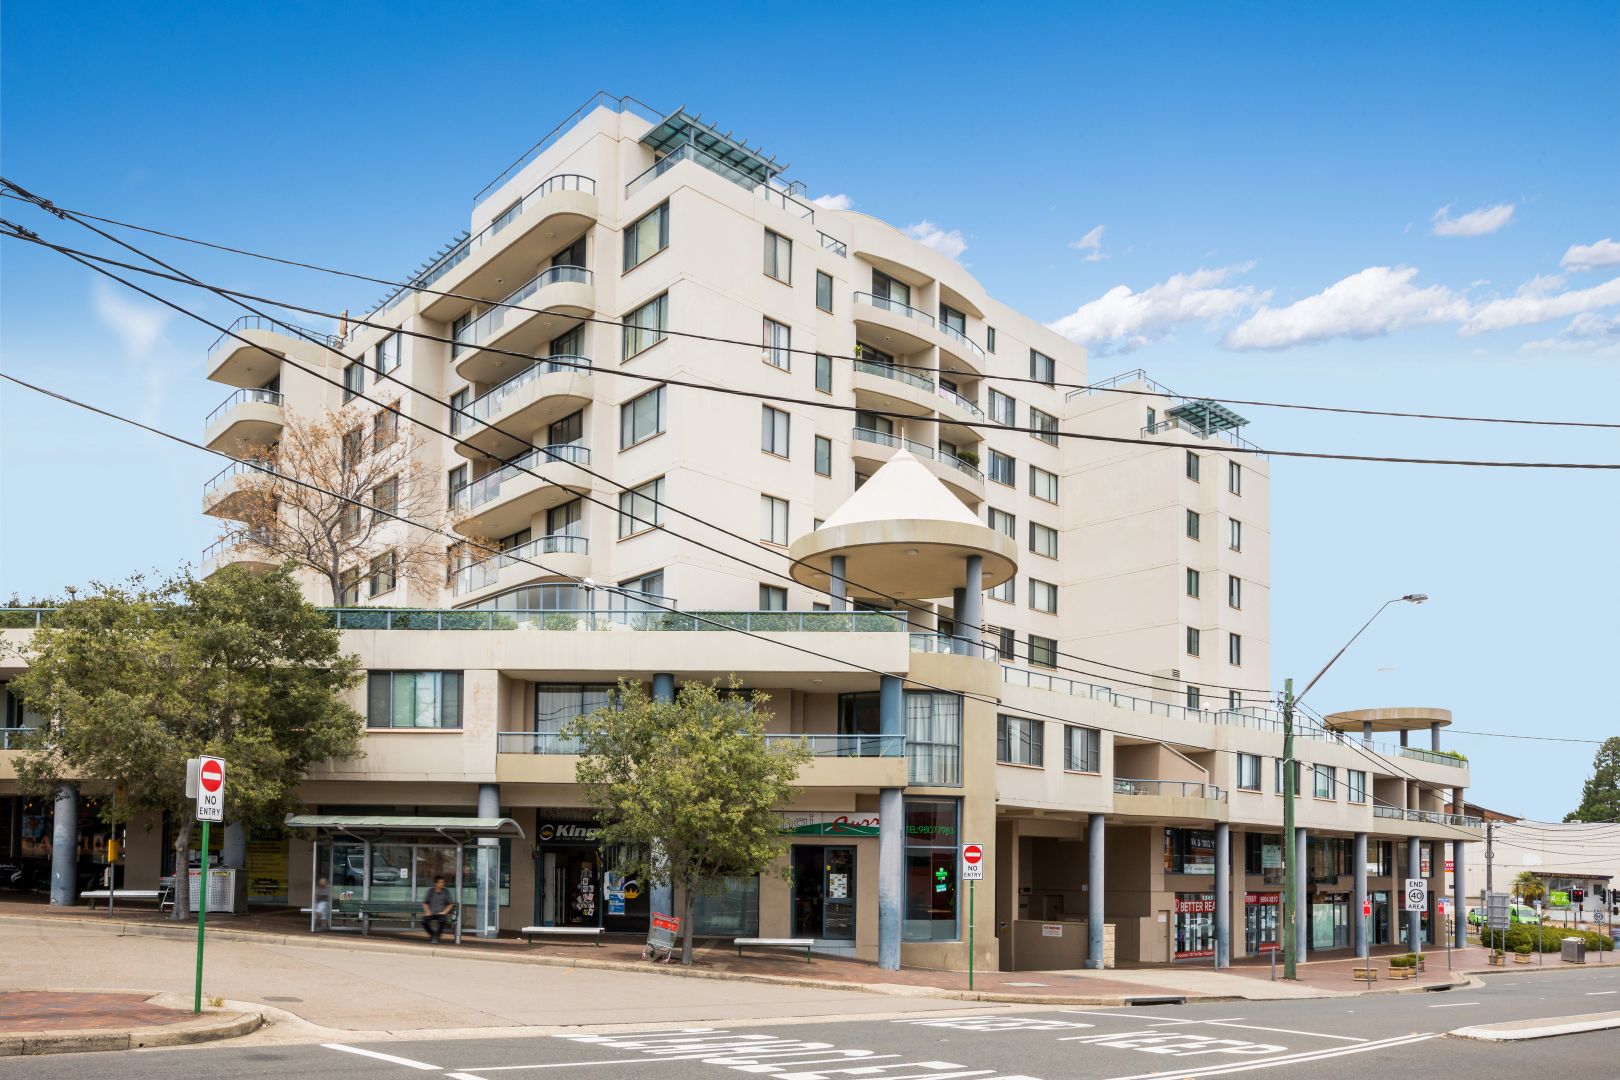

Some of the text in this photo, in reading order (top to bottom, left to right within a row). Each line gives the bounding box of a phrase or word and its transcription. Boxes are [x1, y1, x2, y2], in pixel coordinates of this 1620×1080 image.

[204, 795, 217, 805] NO
[199, 807, 221, 816] ENTRY
[779, 812, 814, 829] hai
[832, 815, 880, 833] Curr
[555, 824, 602, 841] King
[1411, 892, 1422, 900] 40
[1180, 900, 1215, 912] BETTER REA
[1056, 1030, 1288, 1057] KEEP
[702, 1049, 1046, 1080] CLEA
